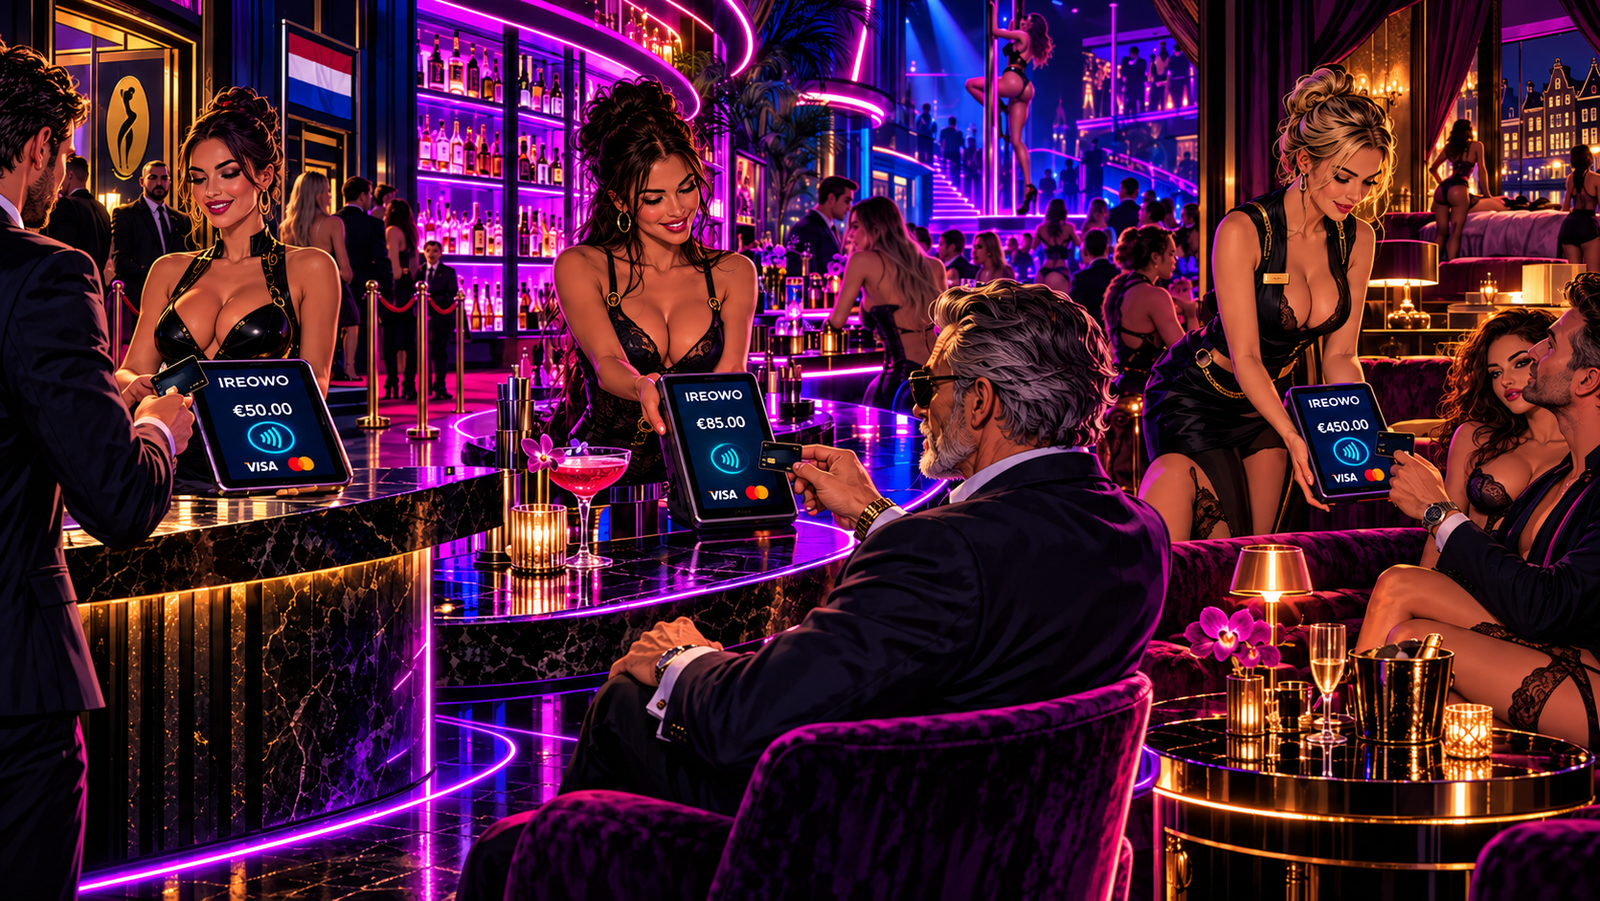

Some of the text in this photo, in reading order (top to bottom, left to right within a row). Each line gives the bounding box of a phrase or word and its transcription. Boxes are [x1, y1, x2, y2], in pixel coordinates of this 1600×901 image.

[218, 375, 289, 389] IREOWO
[684, 389, 743, 402] IREOWO
[1308, 395, 1360, 409] IREOWO
[232, 402, 293, 418] €50.00
[696, 415, 746, 430] €85.00
[1317, 419, 1369, 434] €450.00
[244, 460, 279, 473] VISA
[1331, 472, 1358, 483] VISA
[708, 489, 738, 501] VISA
